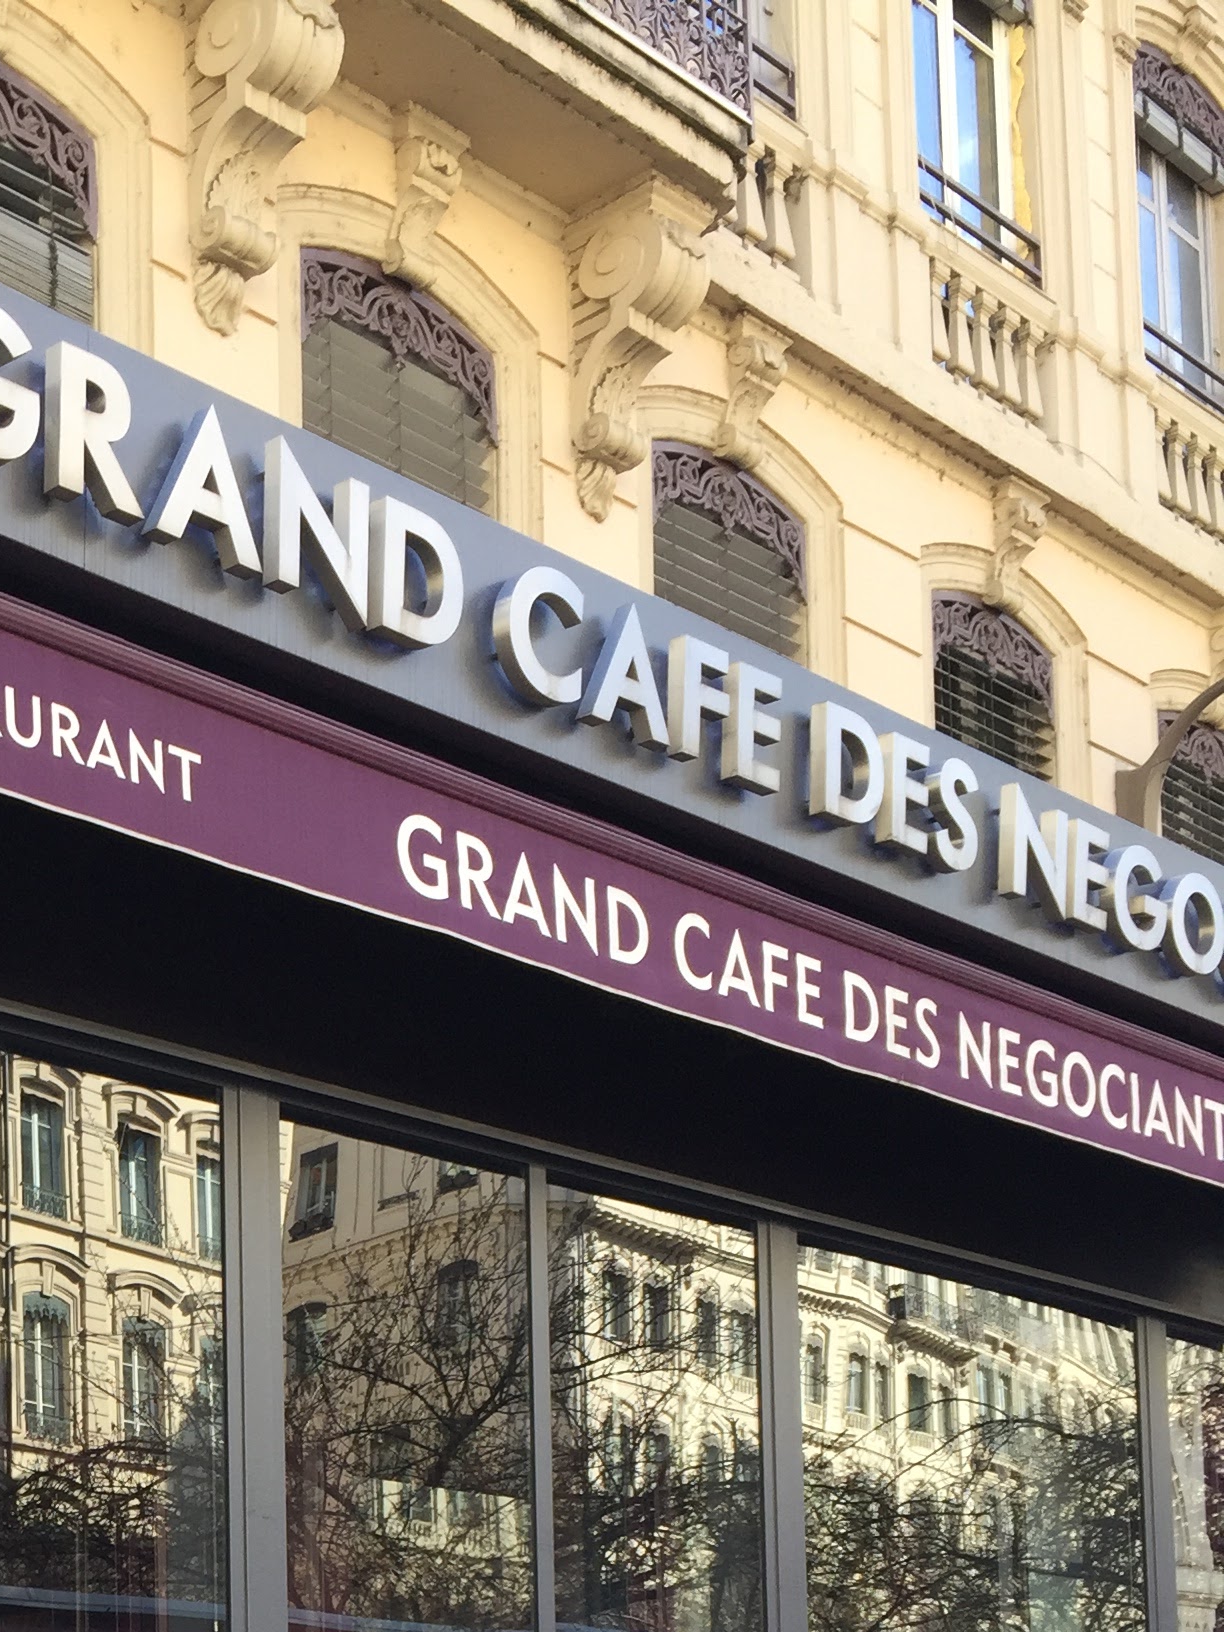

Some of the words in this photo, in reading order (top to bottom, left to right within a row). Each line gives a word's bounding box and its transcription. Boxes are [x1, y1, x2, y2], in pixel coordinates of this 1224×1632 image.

[493, 566, 781, 796] CAFE
[809, 701, 978, 873] DES
[997, 783, 1224, 975] NEGO
[396, 814, 649, 966] GRAND
[675, 913, 824, 1029] CAFE
[844, 970, 941, 1069] DES
[960, 1011, 1224, 1163] NEGOCIANT
